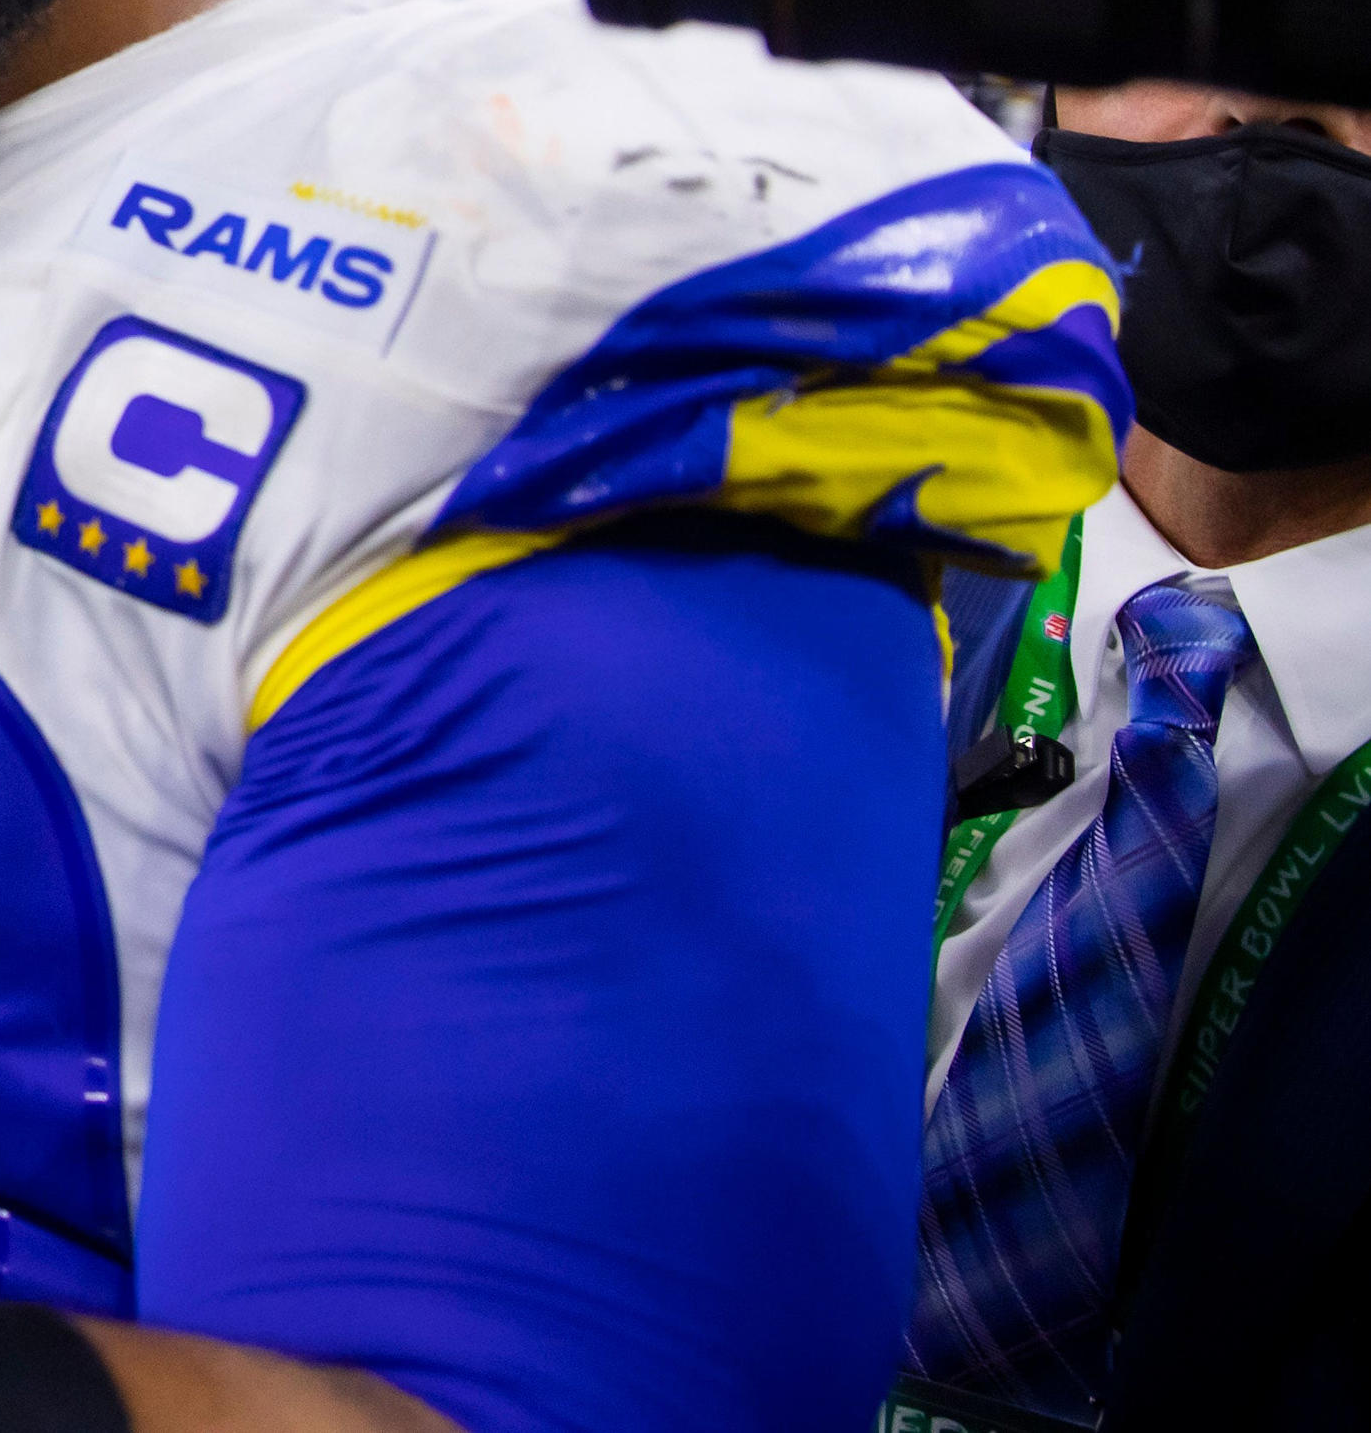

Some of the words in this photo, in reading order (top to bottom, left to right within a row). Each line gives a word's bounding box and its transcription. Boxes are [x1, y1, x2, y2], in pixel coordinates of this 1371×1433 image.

[110, 181, 395, 310] RAMS
[52, 335, 273, 544] C
[1179, 965, 1256, 1114] SUPER
[1240, 842, 1326, 959] BOWL
[1319, 765, 1371, 834] LV
